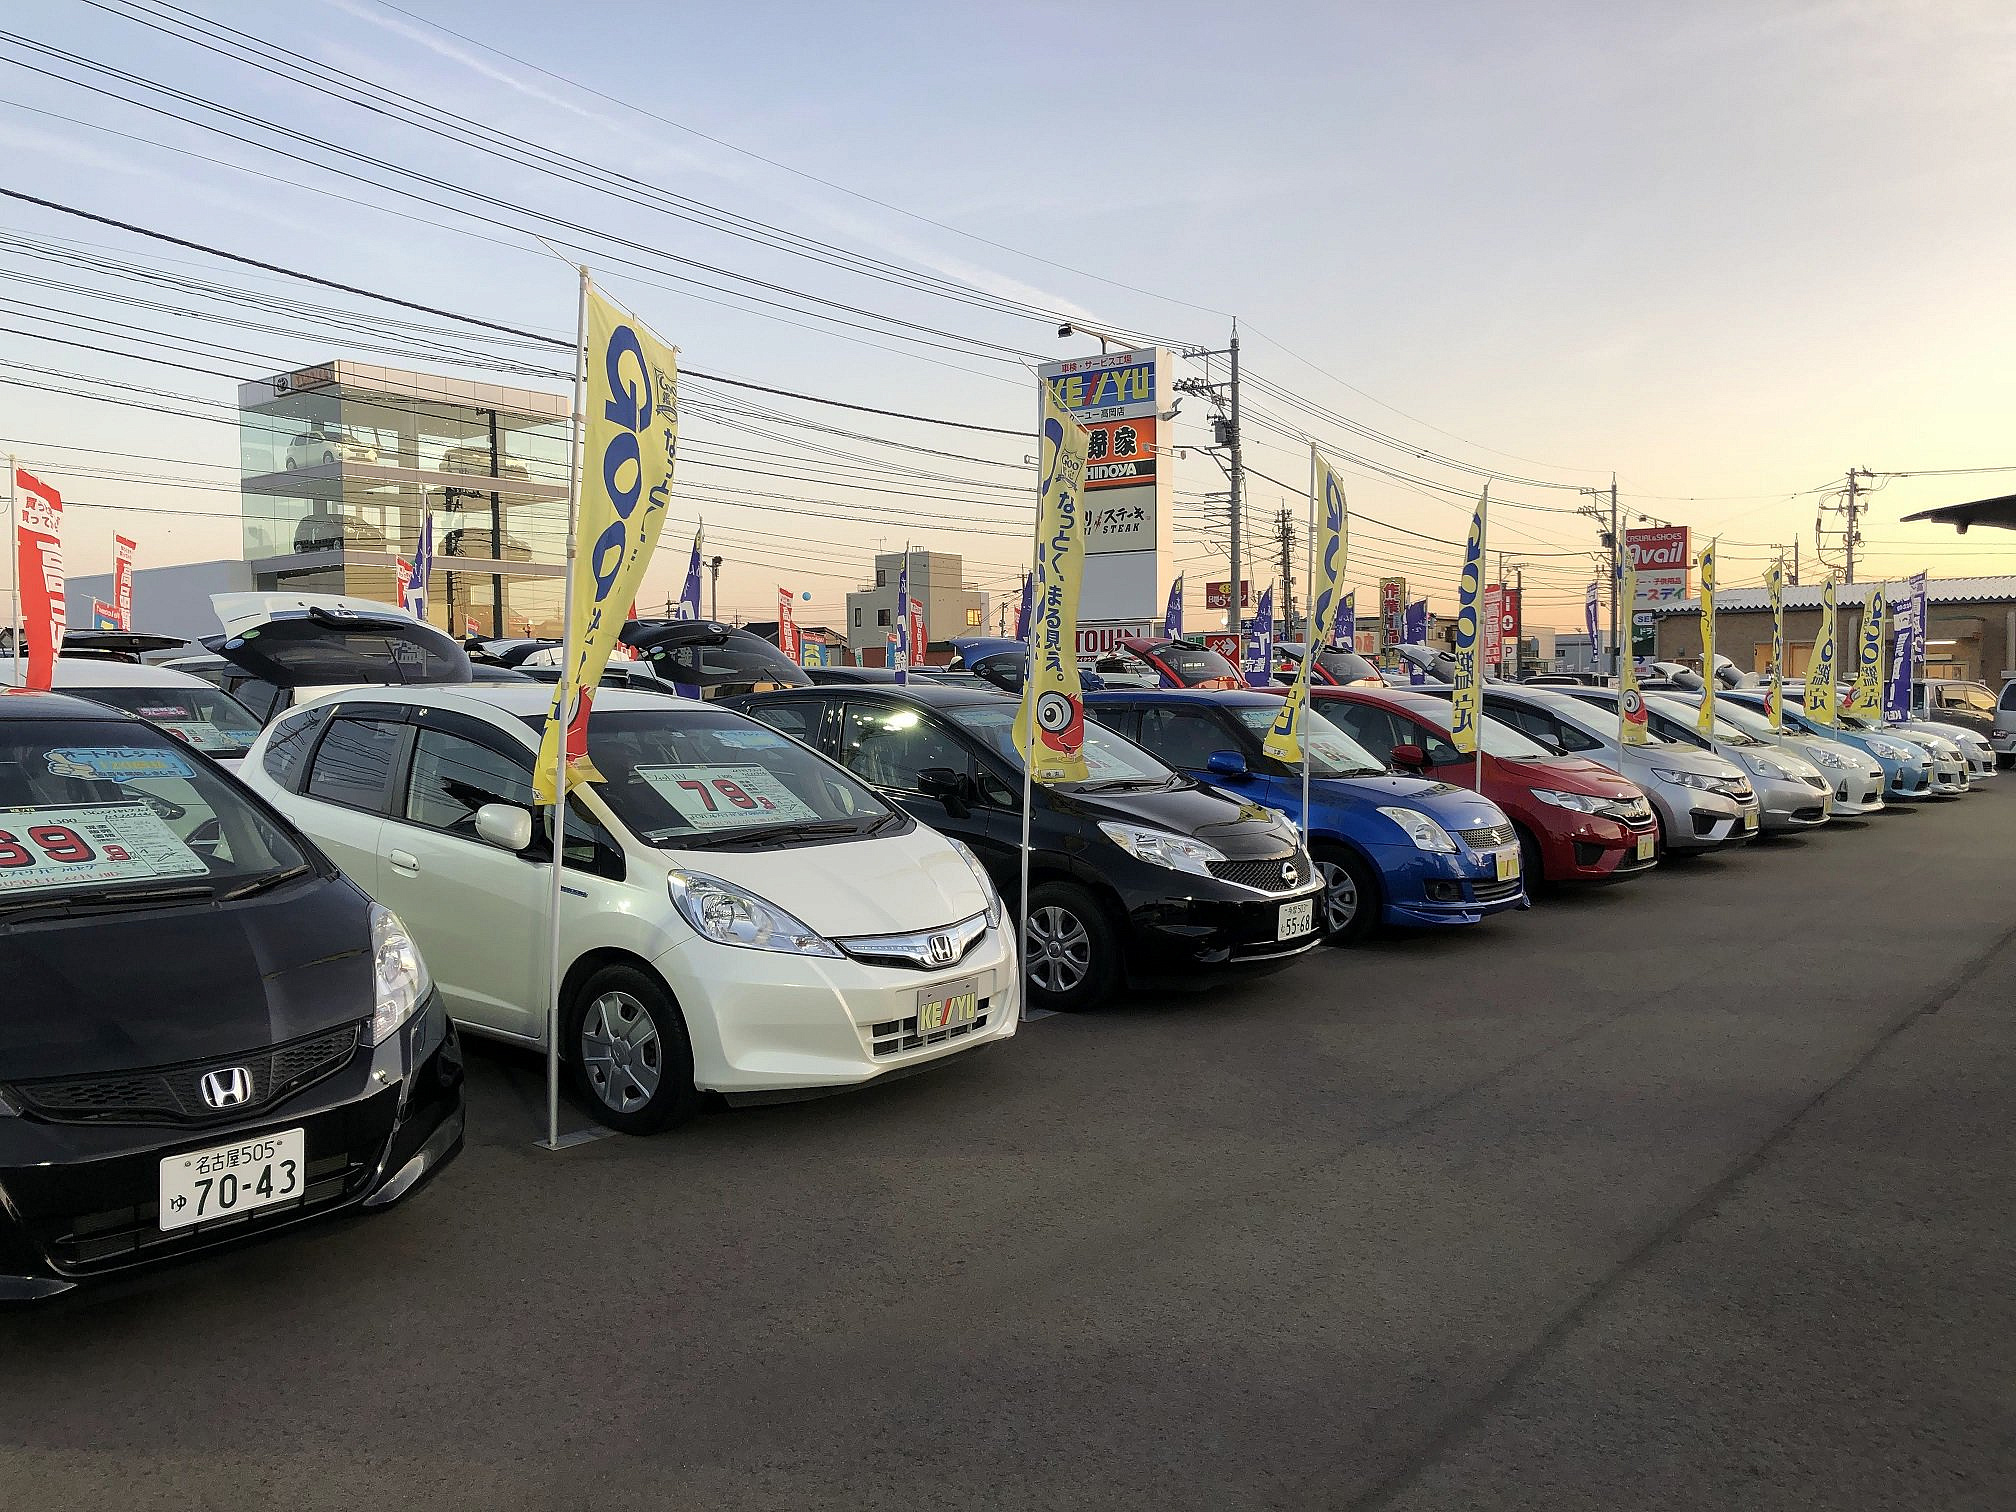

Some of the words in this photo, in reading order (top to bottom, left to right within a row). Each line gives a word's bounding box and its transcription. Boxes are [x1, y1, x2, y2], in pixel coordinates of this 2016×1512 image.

[1103, 523, 1140, 534] STEAK
[1629, 542, 1684, 565] Avail
[1285, 914, 1310, 936] 55-68
[195, 1140, 275, 1175] 名古屋505
[170, 1194, 187, 1213] ゆ
[194, 1159, 297, 1217] 70-43
